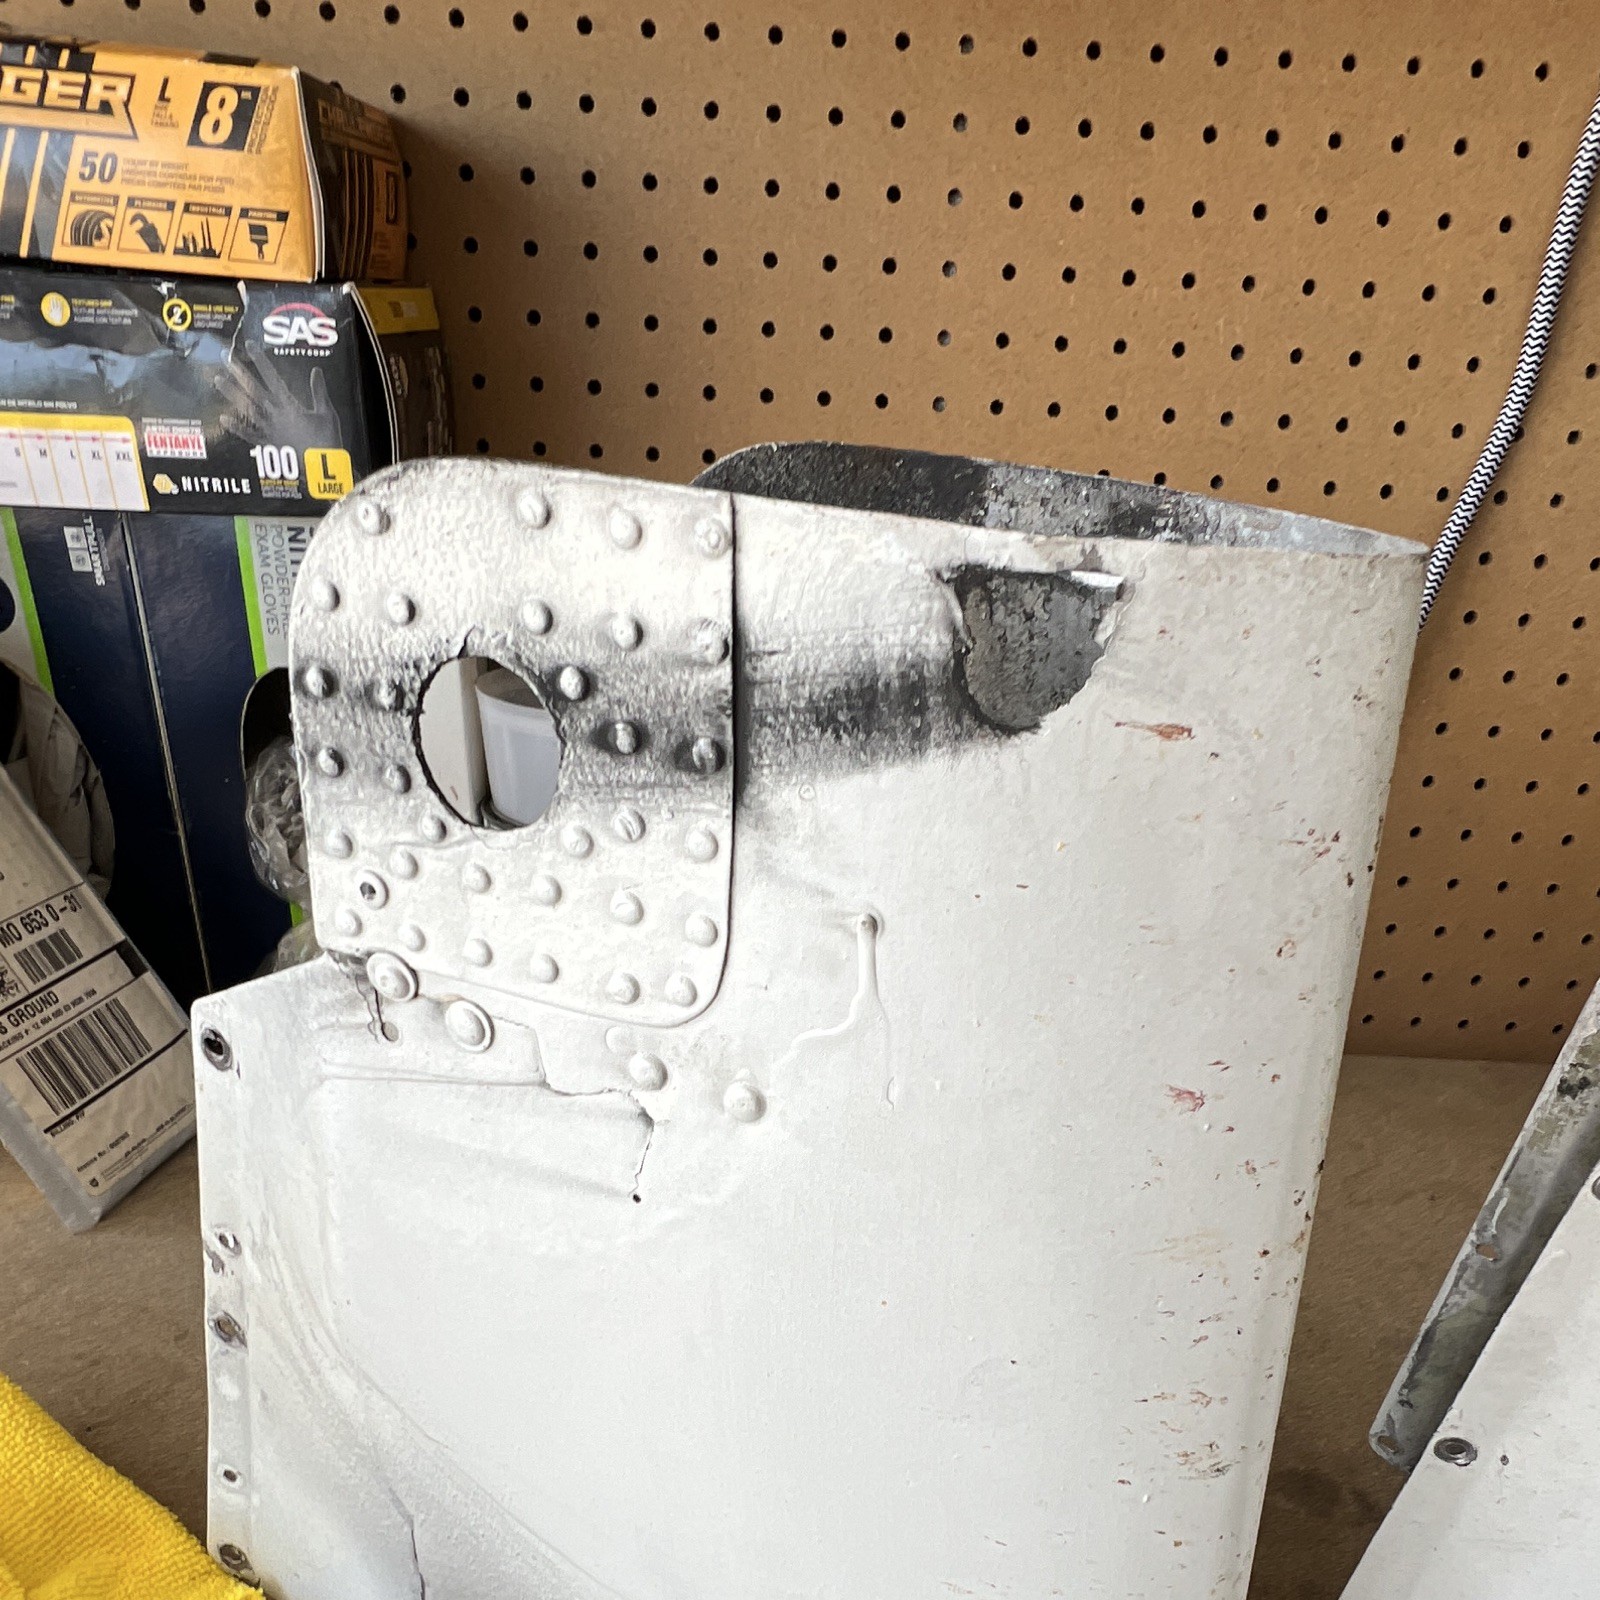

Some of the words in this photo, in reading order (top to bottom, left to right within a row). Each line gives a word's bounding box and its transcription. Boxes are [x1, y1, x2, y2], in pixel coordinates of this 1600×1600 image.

[158, 77, 171, 102] L
[199, 85, 239, 145] 8
[79, 150, 118, 184] 50
[262, 315, 338, 347] SAS
[146, 433, 203, 451] FENTANYL
[249, 444, 299, 481] 100
[320, 453, 336, 480] L
[181, 475, 252, 494] NITRILE
[317, 481, 344, 496] LARGE
[254, 523, 271, 568] EXAM
[261, 572, 280, 636] GLOVES
[20, 908, 49, 935] 653
[7, 990, 60, 1028] GROUND
